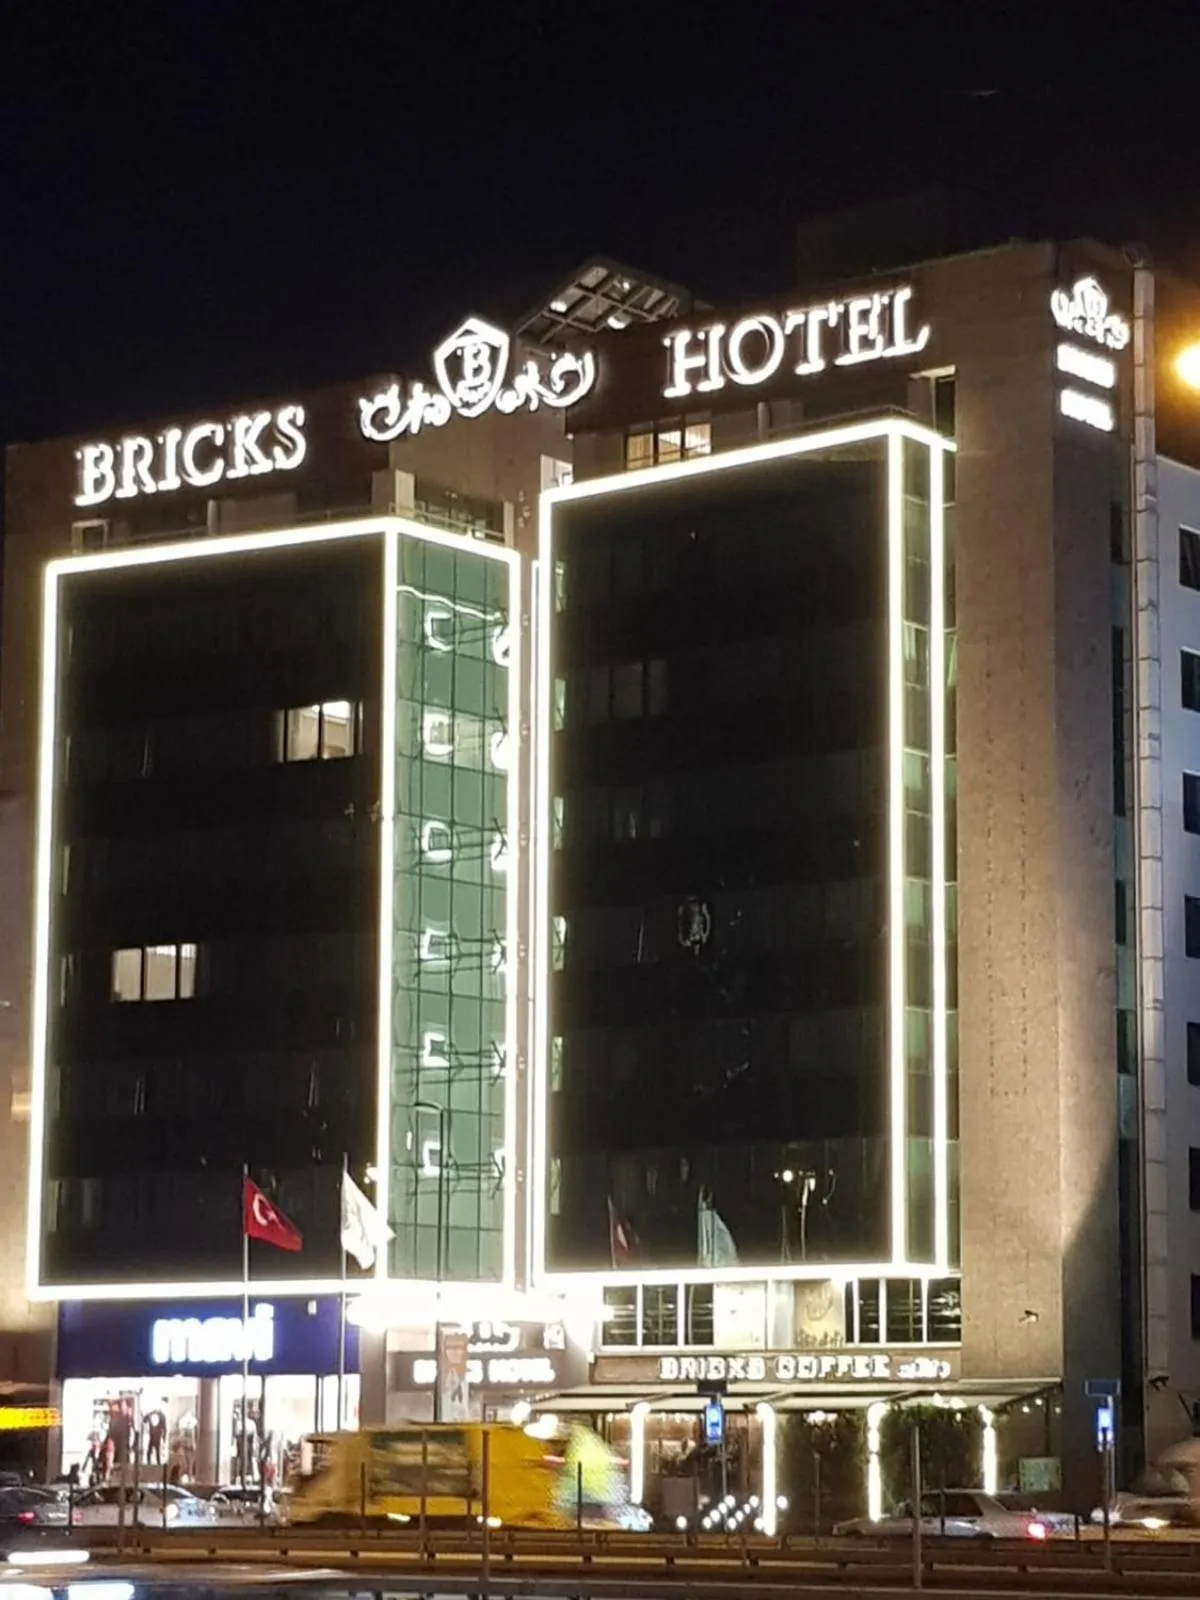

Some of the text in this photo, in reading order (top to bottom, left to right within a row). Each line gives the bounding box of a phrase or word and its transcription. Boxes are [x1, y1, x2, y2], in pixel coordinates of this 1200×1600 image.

[662, 286, 931, 399] HOTEL
[75, 404, 307, 507] BRICKS
[775, 1354, 891, 1379] COFFEE
